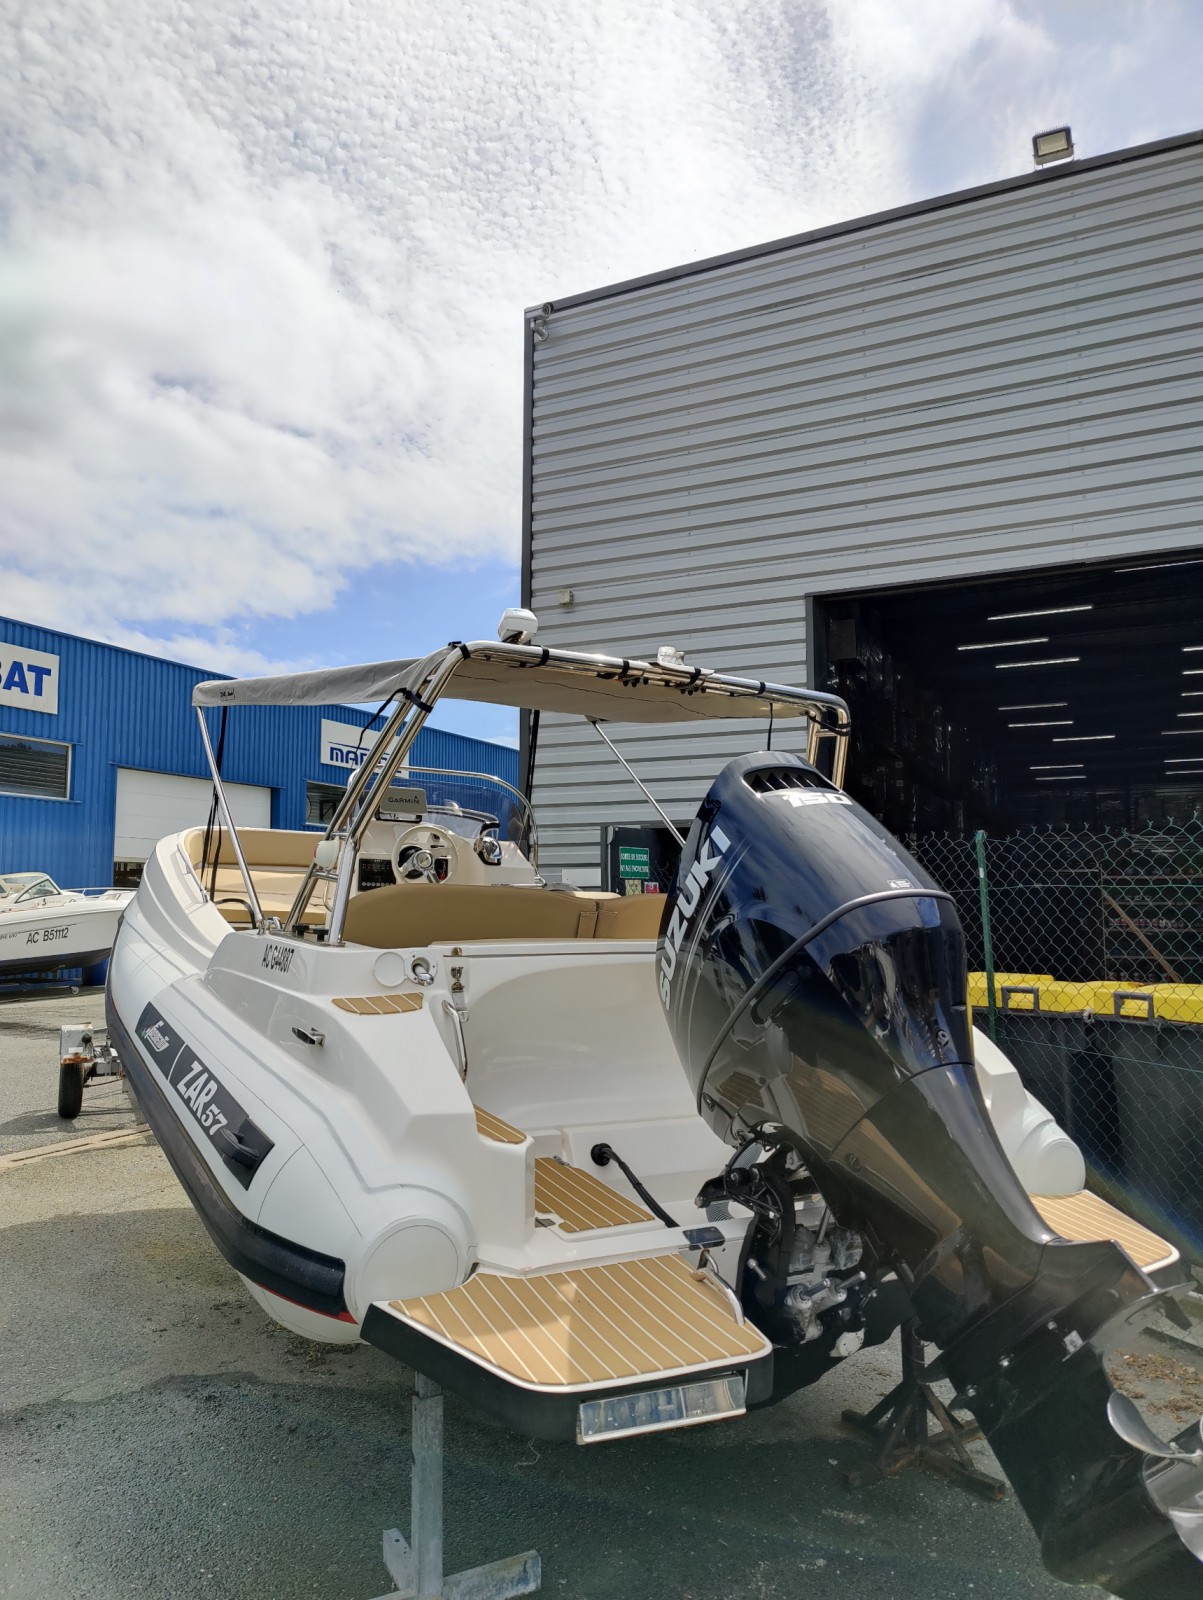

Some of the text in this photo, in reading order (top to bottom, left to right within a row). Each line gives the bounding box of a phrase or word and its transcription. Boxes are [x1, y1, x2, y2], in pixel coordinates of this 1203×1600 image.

[0, 660, 52, 697] AT
[388, 796, 420, 804] GARMIN
[659, 825, 732, 1011] SUZUKI
[26, 927, 69, 945] AC B51112
